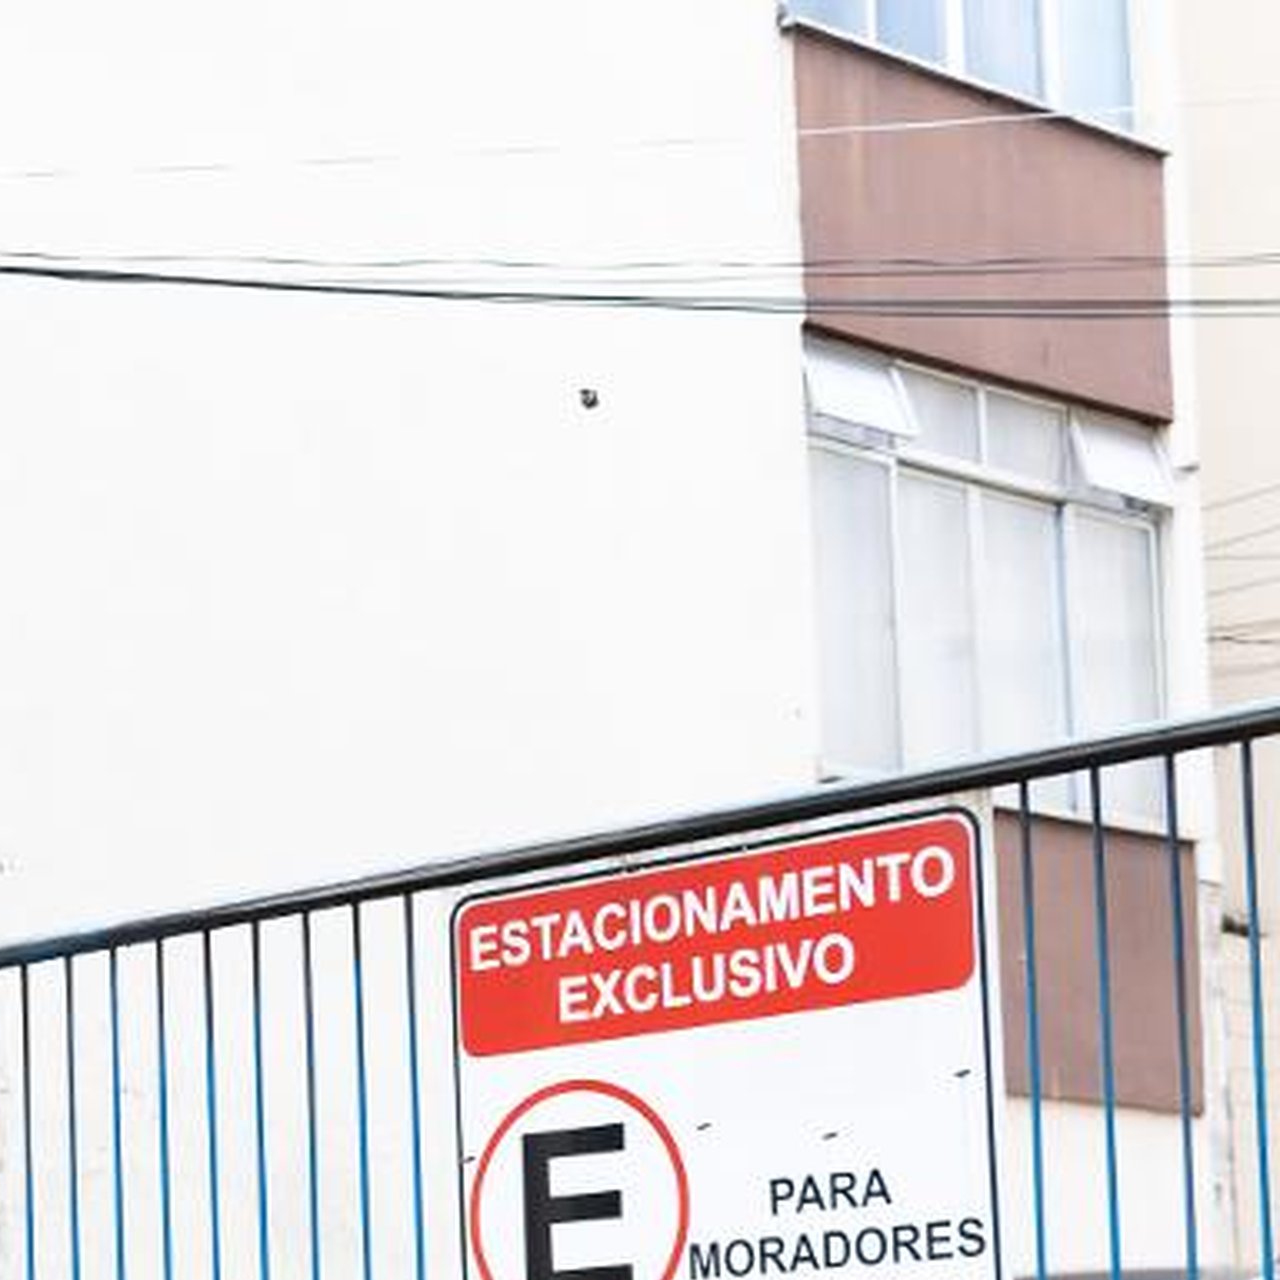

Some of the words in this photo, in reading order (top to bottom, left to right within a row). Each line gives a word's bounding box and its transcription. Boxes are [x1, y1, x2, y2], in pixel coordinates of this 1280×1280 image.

[468, 845, 956, 973] ESTACIONAMENTO
[557, 933, 856, 1025] EXCLUSIVO
[768, 1168, 893, 1216] PARA
[688, 1218, 986, 1280] MORADORES
